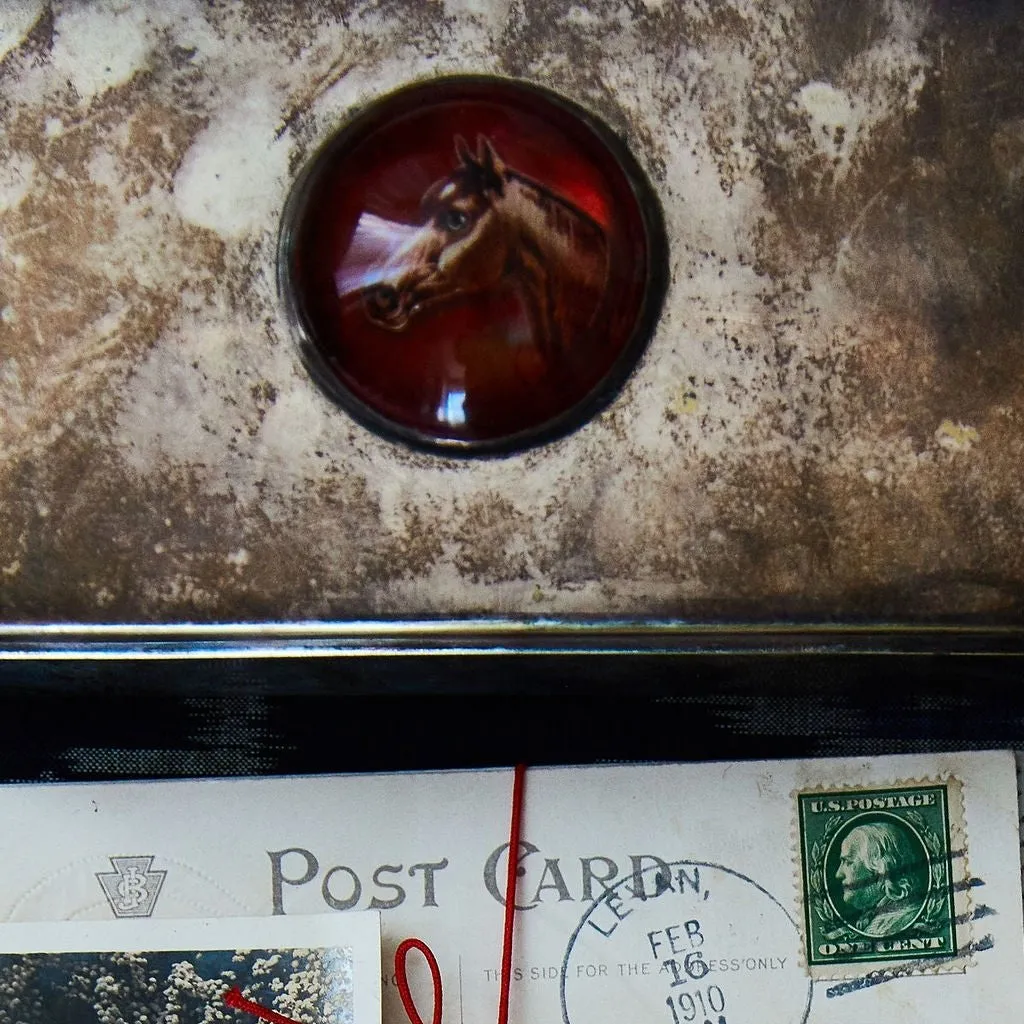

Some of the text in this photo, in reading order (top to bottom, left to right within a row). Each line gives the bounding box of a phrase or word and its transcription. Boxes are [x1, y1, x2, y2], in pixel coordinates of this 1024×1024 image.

[647, 919, 705, 960] FEB
[877, 936, 944, 953] CENT
[484, 967, 524, 982] THS
[577, 964, 608, 978] FOR
[618, 962, 650, 976] THE
[663, 951, 711, 988] 16
[666, 985, 726, 1024] 1910
